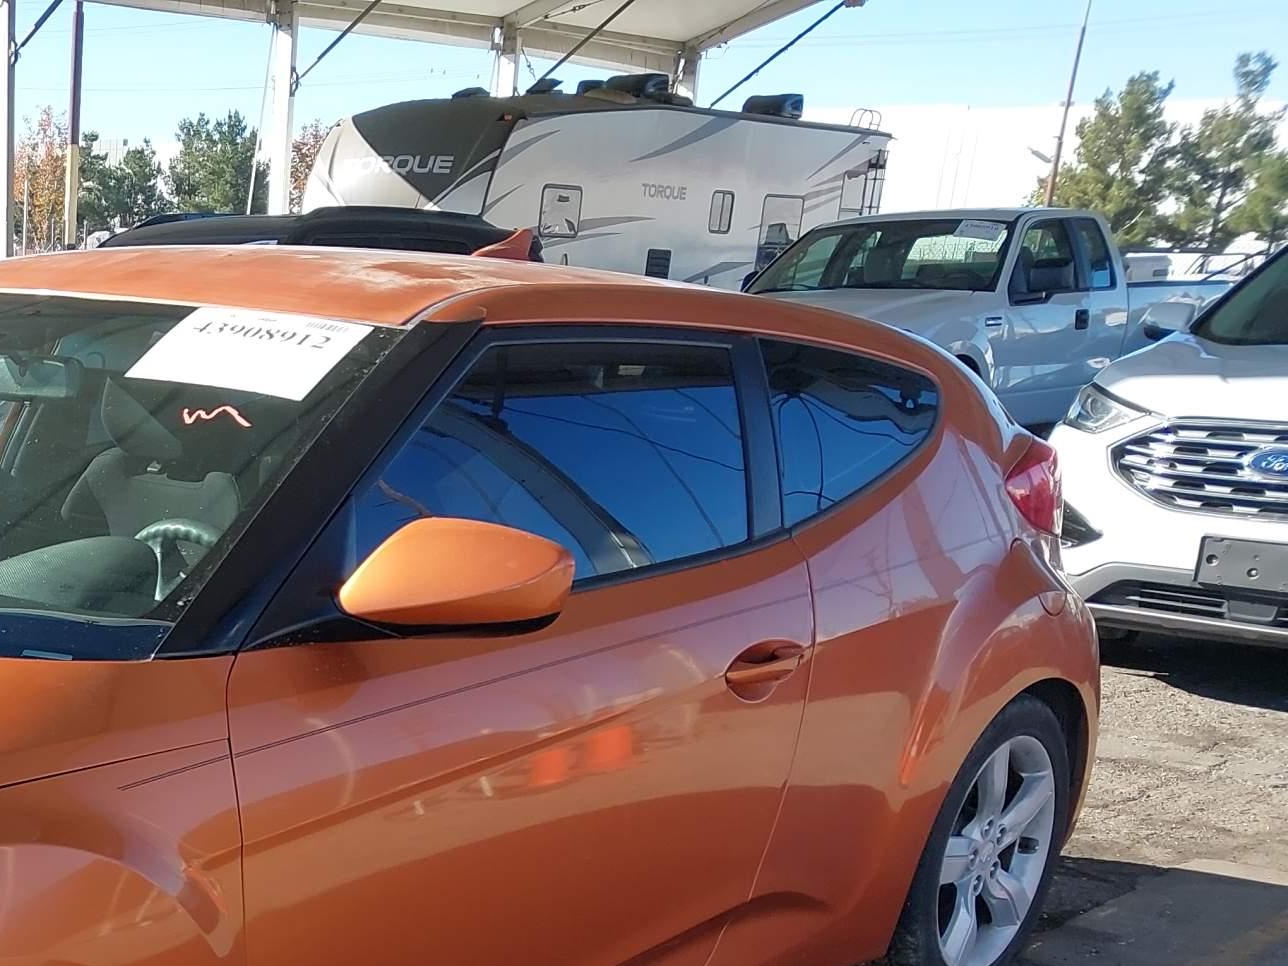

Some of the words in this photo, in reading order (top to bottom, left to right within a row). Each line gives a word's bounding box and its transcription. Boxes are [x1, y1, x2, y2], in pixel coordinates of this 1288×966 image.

[344, 155, 454, 175] ORQUE
[641, 183, 687, 200] TORQUE
[193, 321, 332, 350] 43908912
